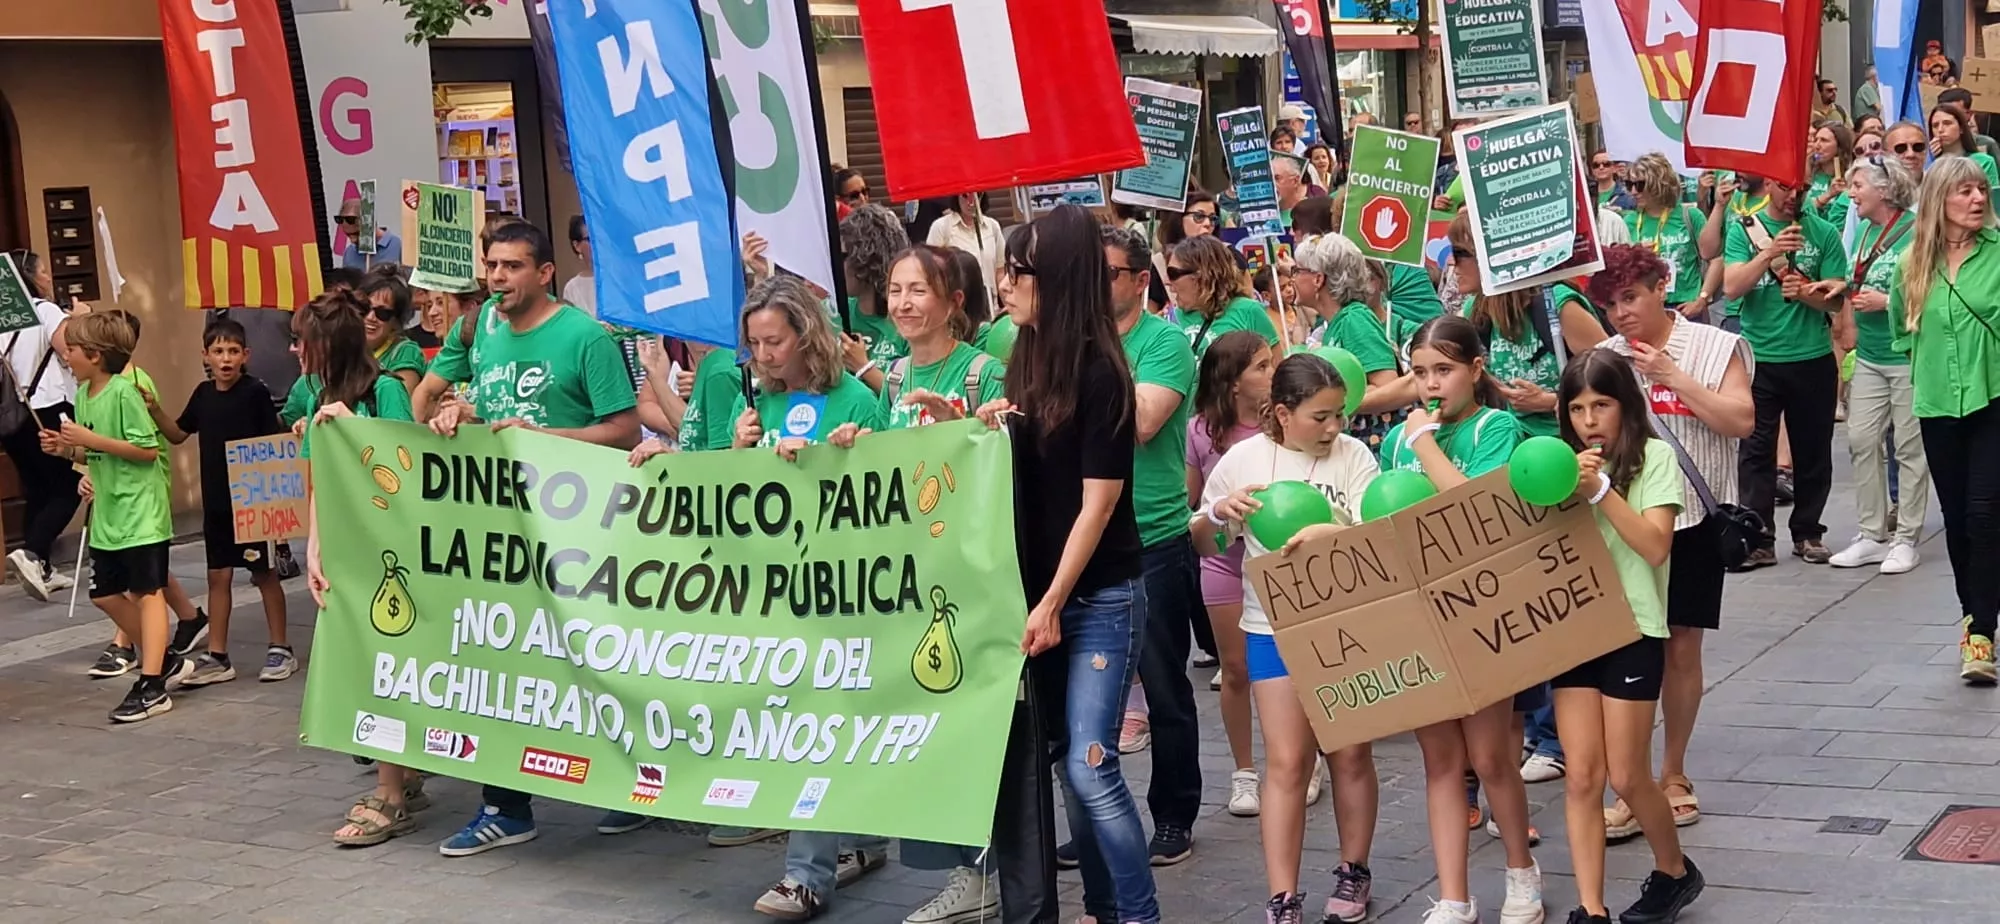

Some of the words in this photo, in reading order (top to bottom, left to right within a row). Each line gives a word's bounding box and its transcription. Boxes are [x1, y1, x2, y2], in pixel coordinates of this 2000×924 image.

[1455, 9, 1525, 27] EDUCATIVA
[1471, 44, 1501, 53] CONTRA
[1503, 42, 1513, 50] LA
[1385, 135, 1408, 151] NO
[1489, 128, 1547, 155] HUELGA
[1384, 157, 1403, 172] AL
[1480, 145, 1563, 178] EDUCATIVA
[1350, 172, 1431, 199] CONCIERTO
[1502, 192, 1540, 208] CONTRA
[1540, 188, 1552, 197] LA
[432, 191, 458, 224] NO!
[420, 223, 429, 239] AL
[429, 224, 472, 245] CONCIERTO
[1492, 227, 1508, 235] DEL
[1509, 209, 1565, 231] BACHILLERATO
[419, 240, 461, 260] EDUCATIVO
[462, 246, 473, 262] EN
[421, 452, 589, 521] DINERO
[600, 468, 804, 547] PÚBLICO,
[816, 467, 912, 533] PARA
[235, 508, 256, 539] FP
[1536, 533, 1580, 575] SE
[420, 525, 471, 579] LA
[483, 532, 750, 617] EDUCACIÓN
[760, 544, 924, 618] PÚBLICA
[1472, 565, 1605, 654] VENDE!
[451, 598, 516, 656] ¡NO
[520, 607, 567, 660] AL
[562, 618, 808, 688] CONCIERTO
[813, 637, 872, 691] DEL
[1310, 628, 1368, 669] LA
[373, 651, 634, 754] BACHILLERATO,
[645, 699, 715, 757] 0-3
[722, 694, 845, 763] AÑOS
[844, 715, 882, 764] Y
[870, 712, 941, 764] FP!
[428, 728, 450, 741] CGT
[523, 751, 570, 776] CCOO
